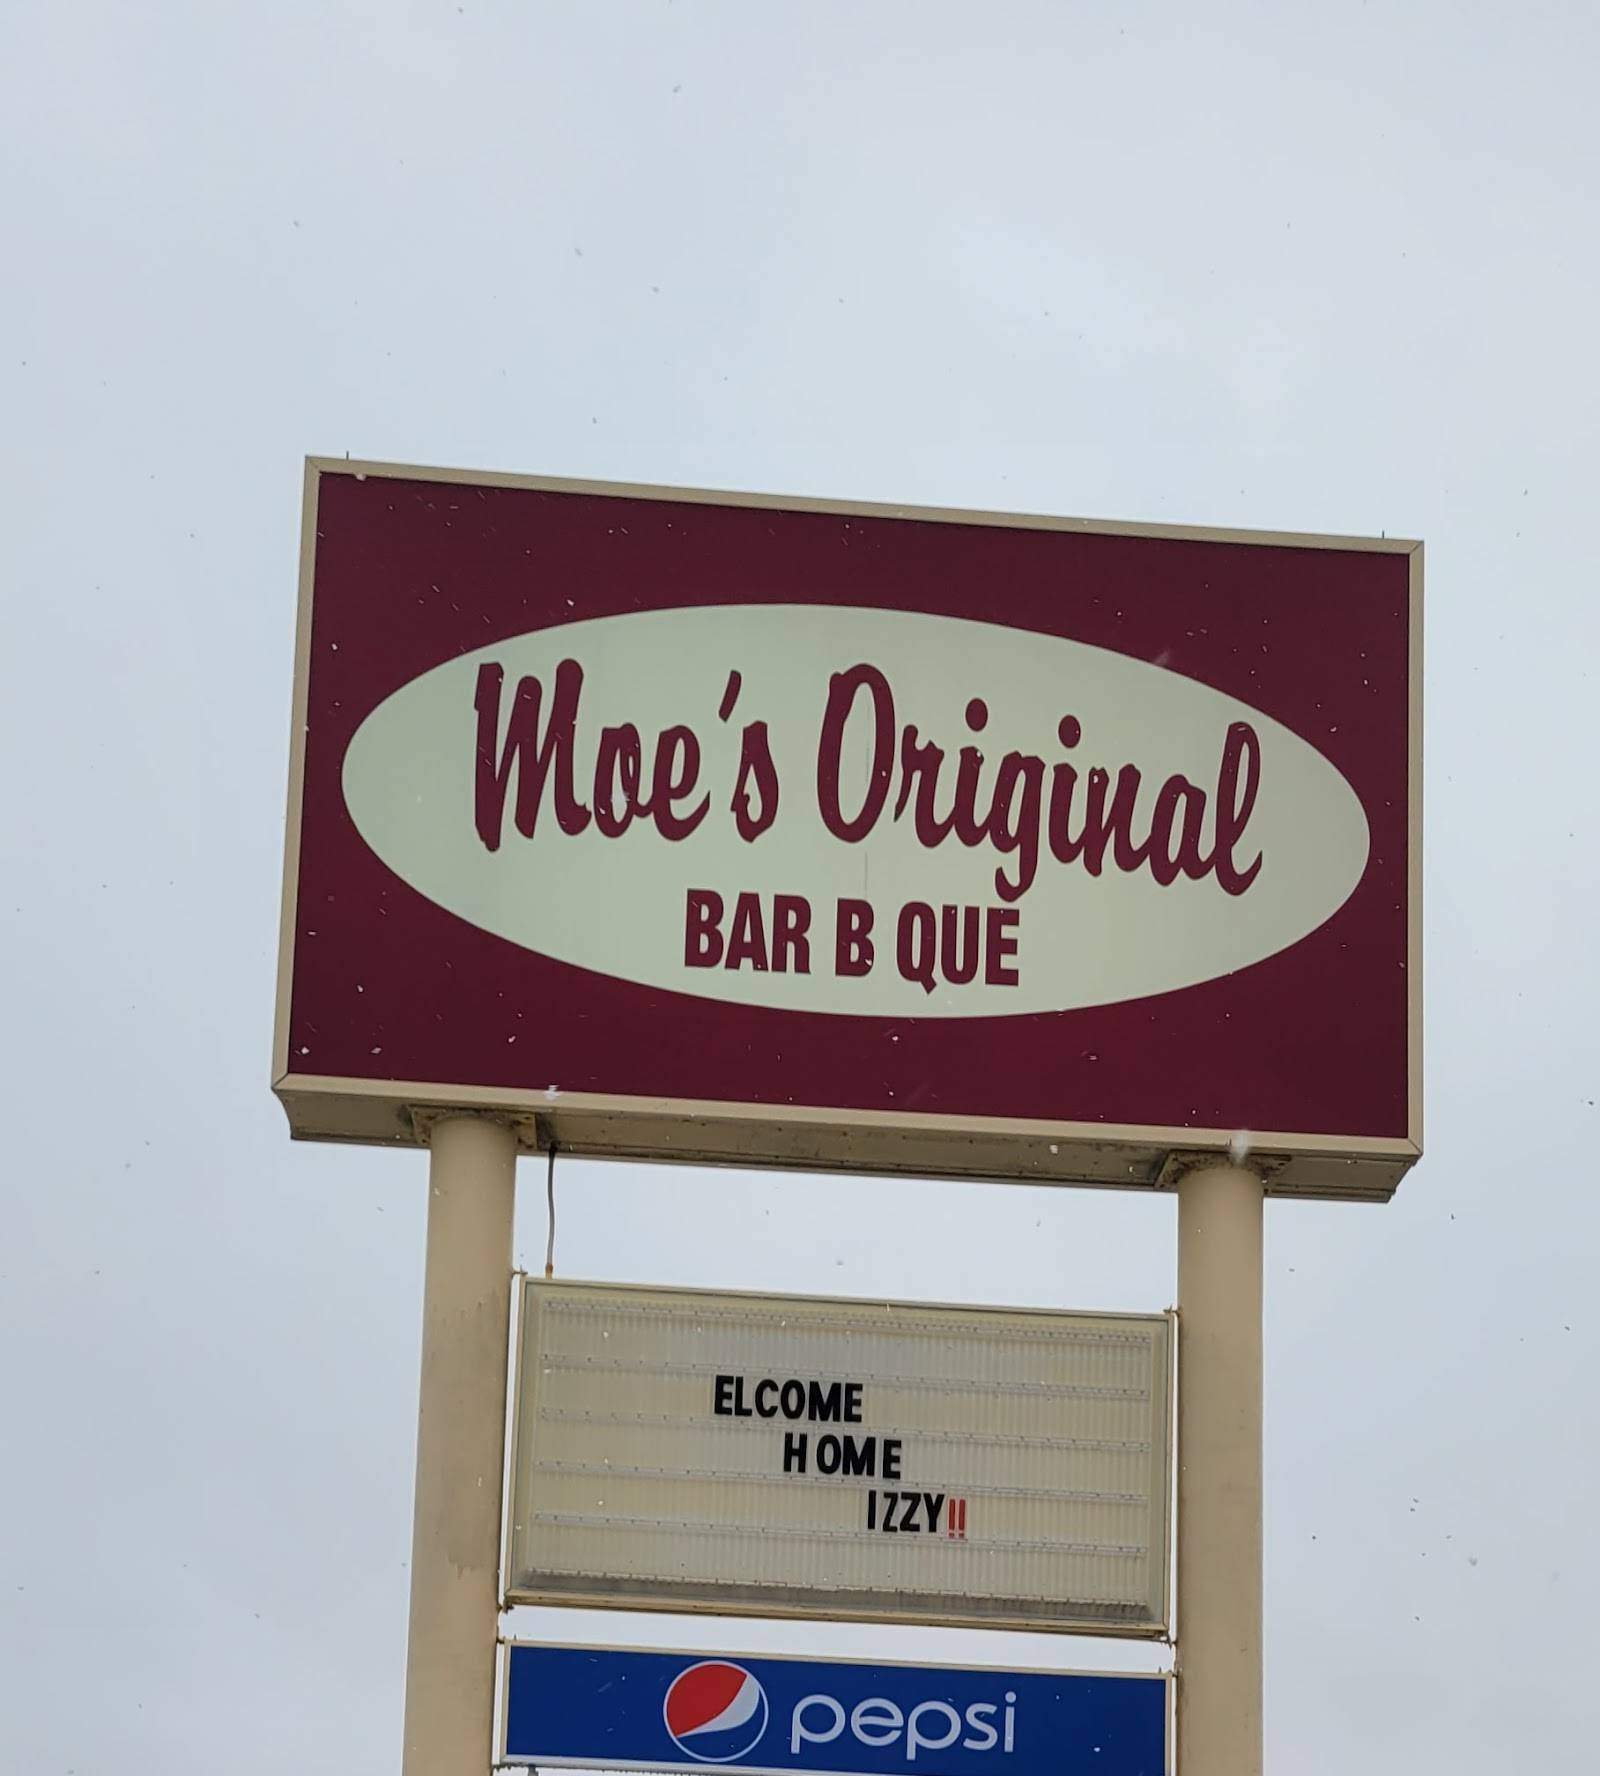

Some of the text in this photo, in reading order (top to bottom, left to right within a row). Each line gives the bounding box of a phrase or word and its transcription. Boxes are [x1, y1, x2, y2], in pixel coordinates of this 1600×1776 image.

[473, 657, 1264, 903] Moe's Original
[684, 888, 1021, 996] BAR B QUE
[713, 1374, 864, 1424] ELCOME
[783, 1431, 903, 1481] HOME
[791, 1691, 1016, 1760] pepsi
